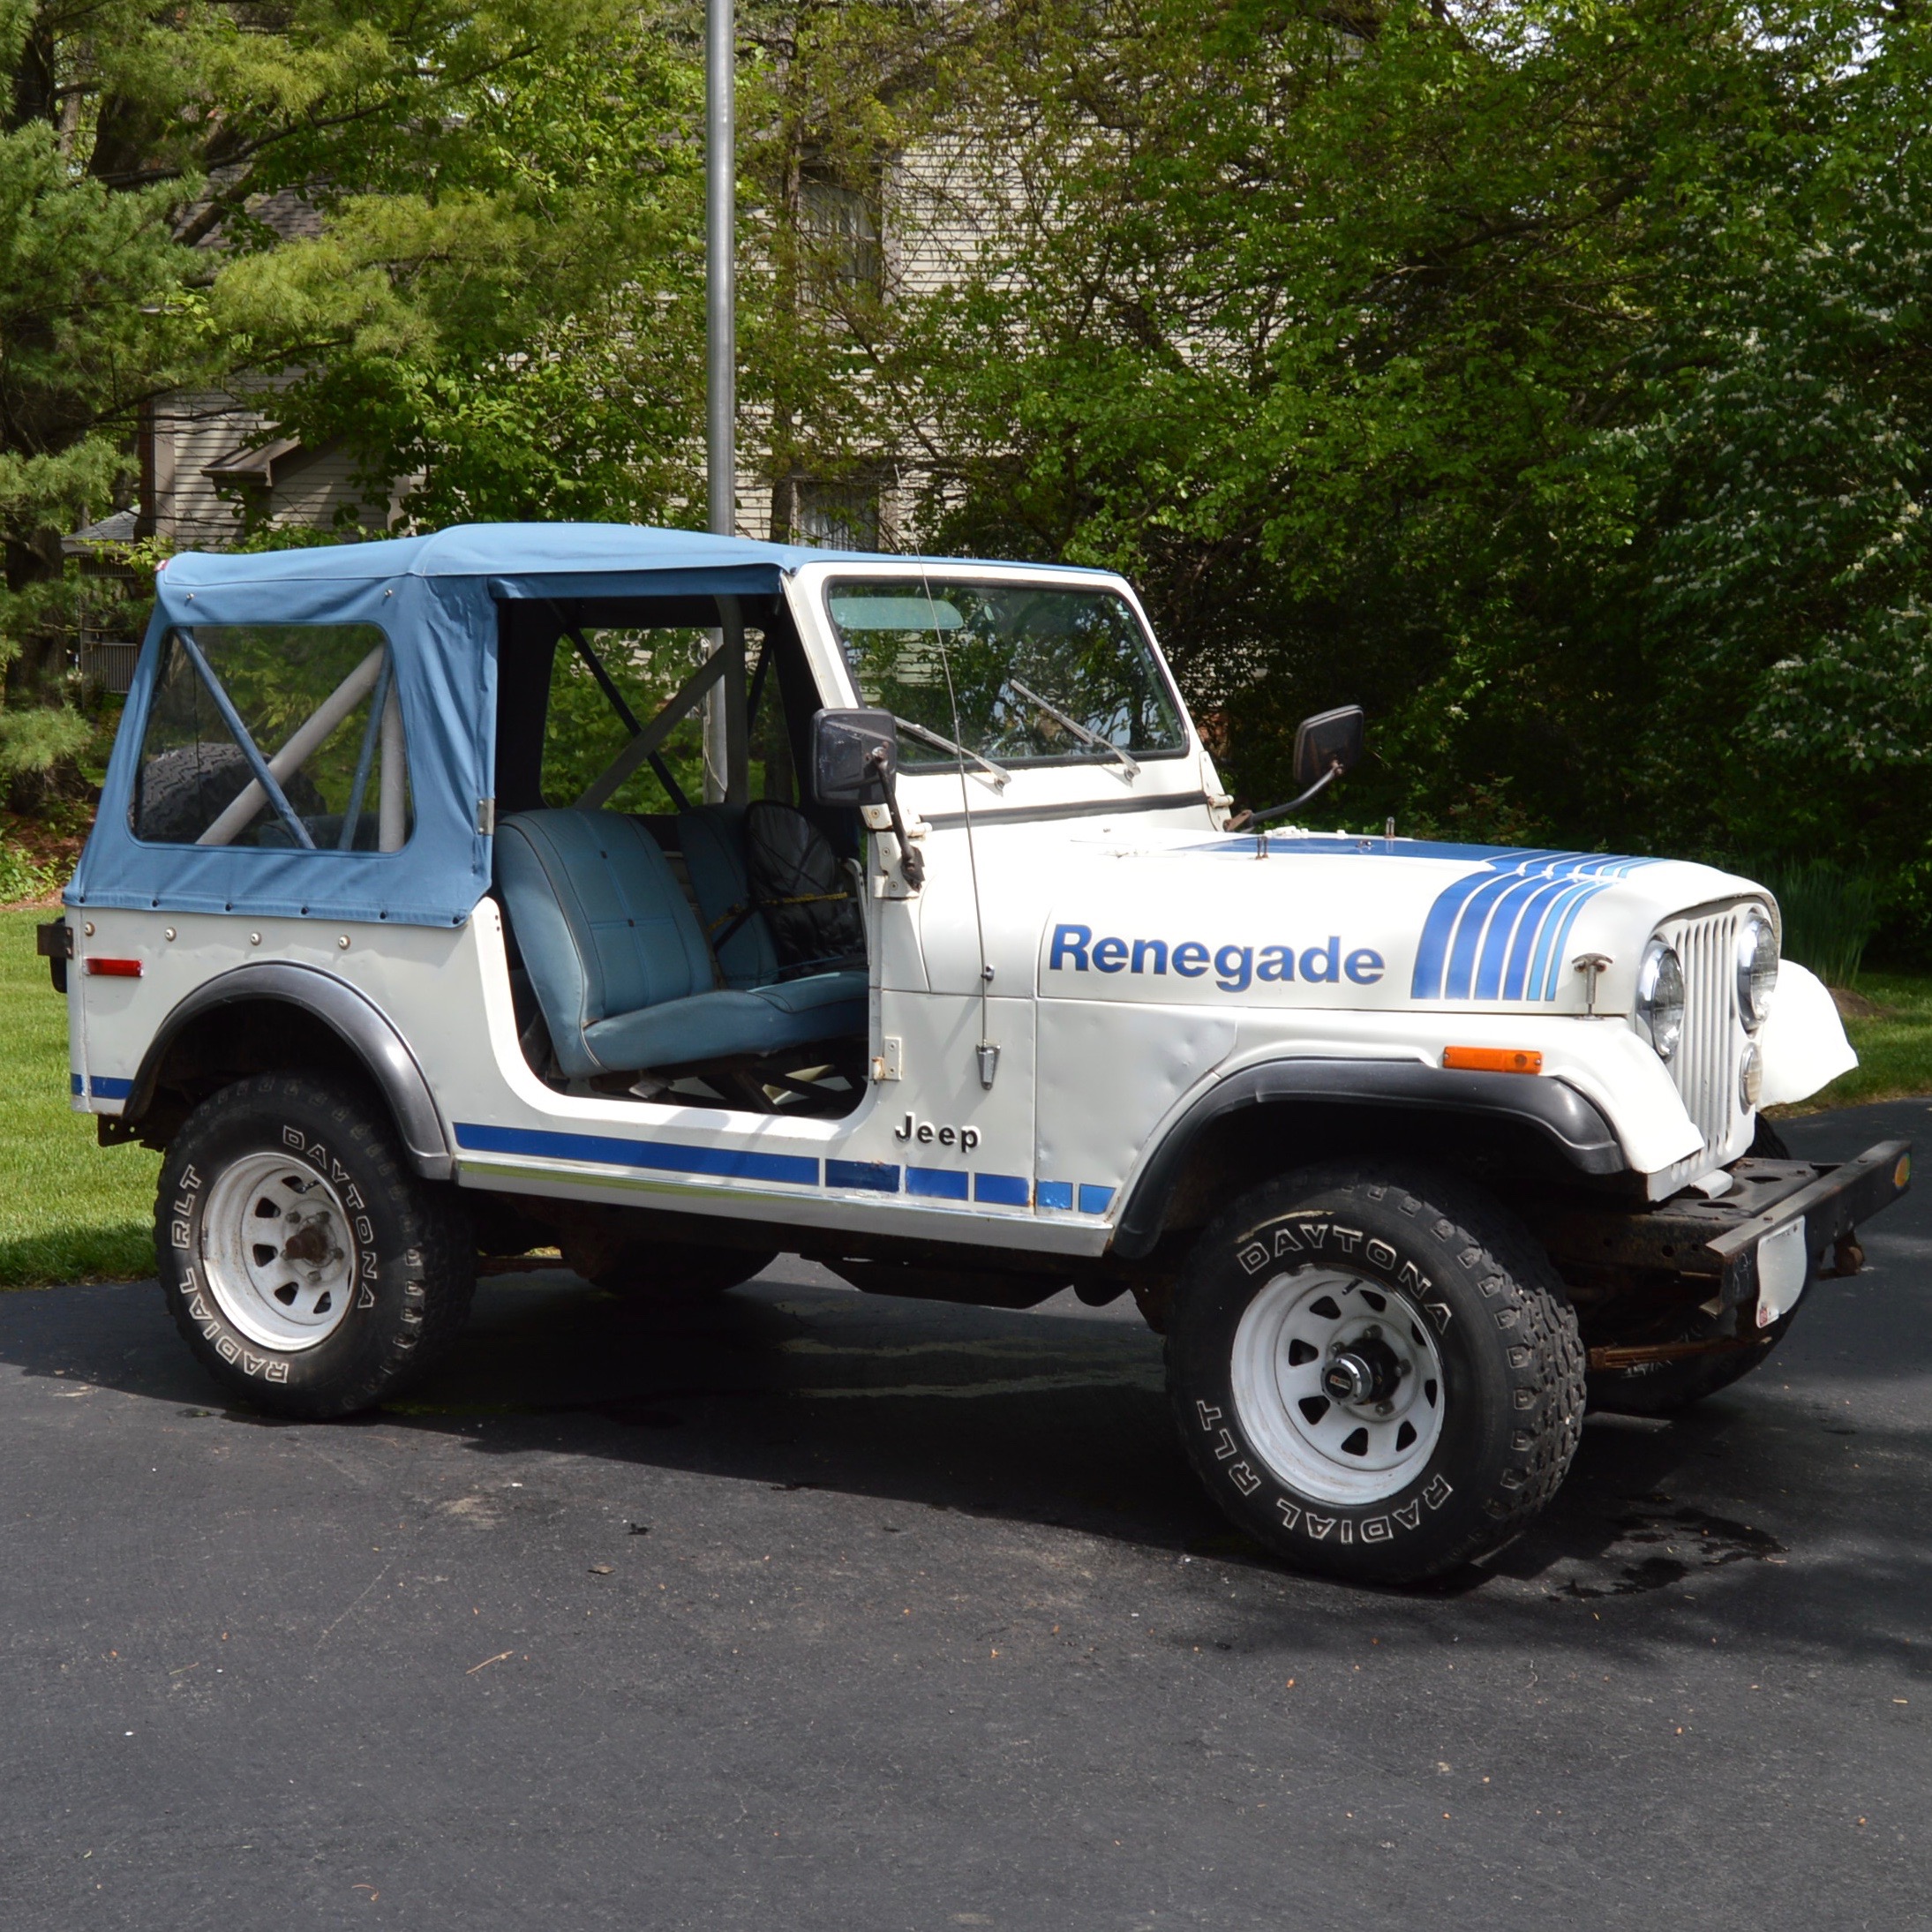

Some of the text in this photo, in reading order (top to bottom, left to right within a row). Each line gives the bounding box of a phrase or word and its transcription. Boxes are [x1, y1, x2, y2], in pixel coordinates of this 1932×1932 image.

[1049, 923, 1386, 993] Renegade
[895, 1111, 981, 1154] Jeep
[171, 1164, 289, 1384] RADIAL RLT
[282, 1125, 378, 1309] DAYTONA
[1236, 1223, 1453, 1334] DAYTONA
[1196, 1400, 1455, 1545] RADIAL RLT
